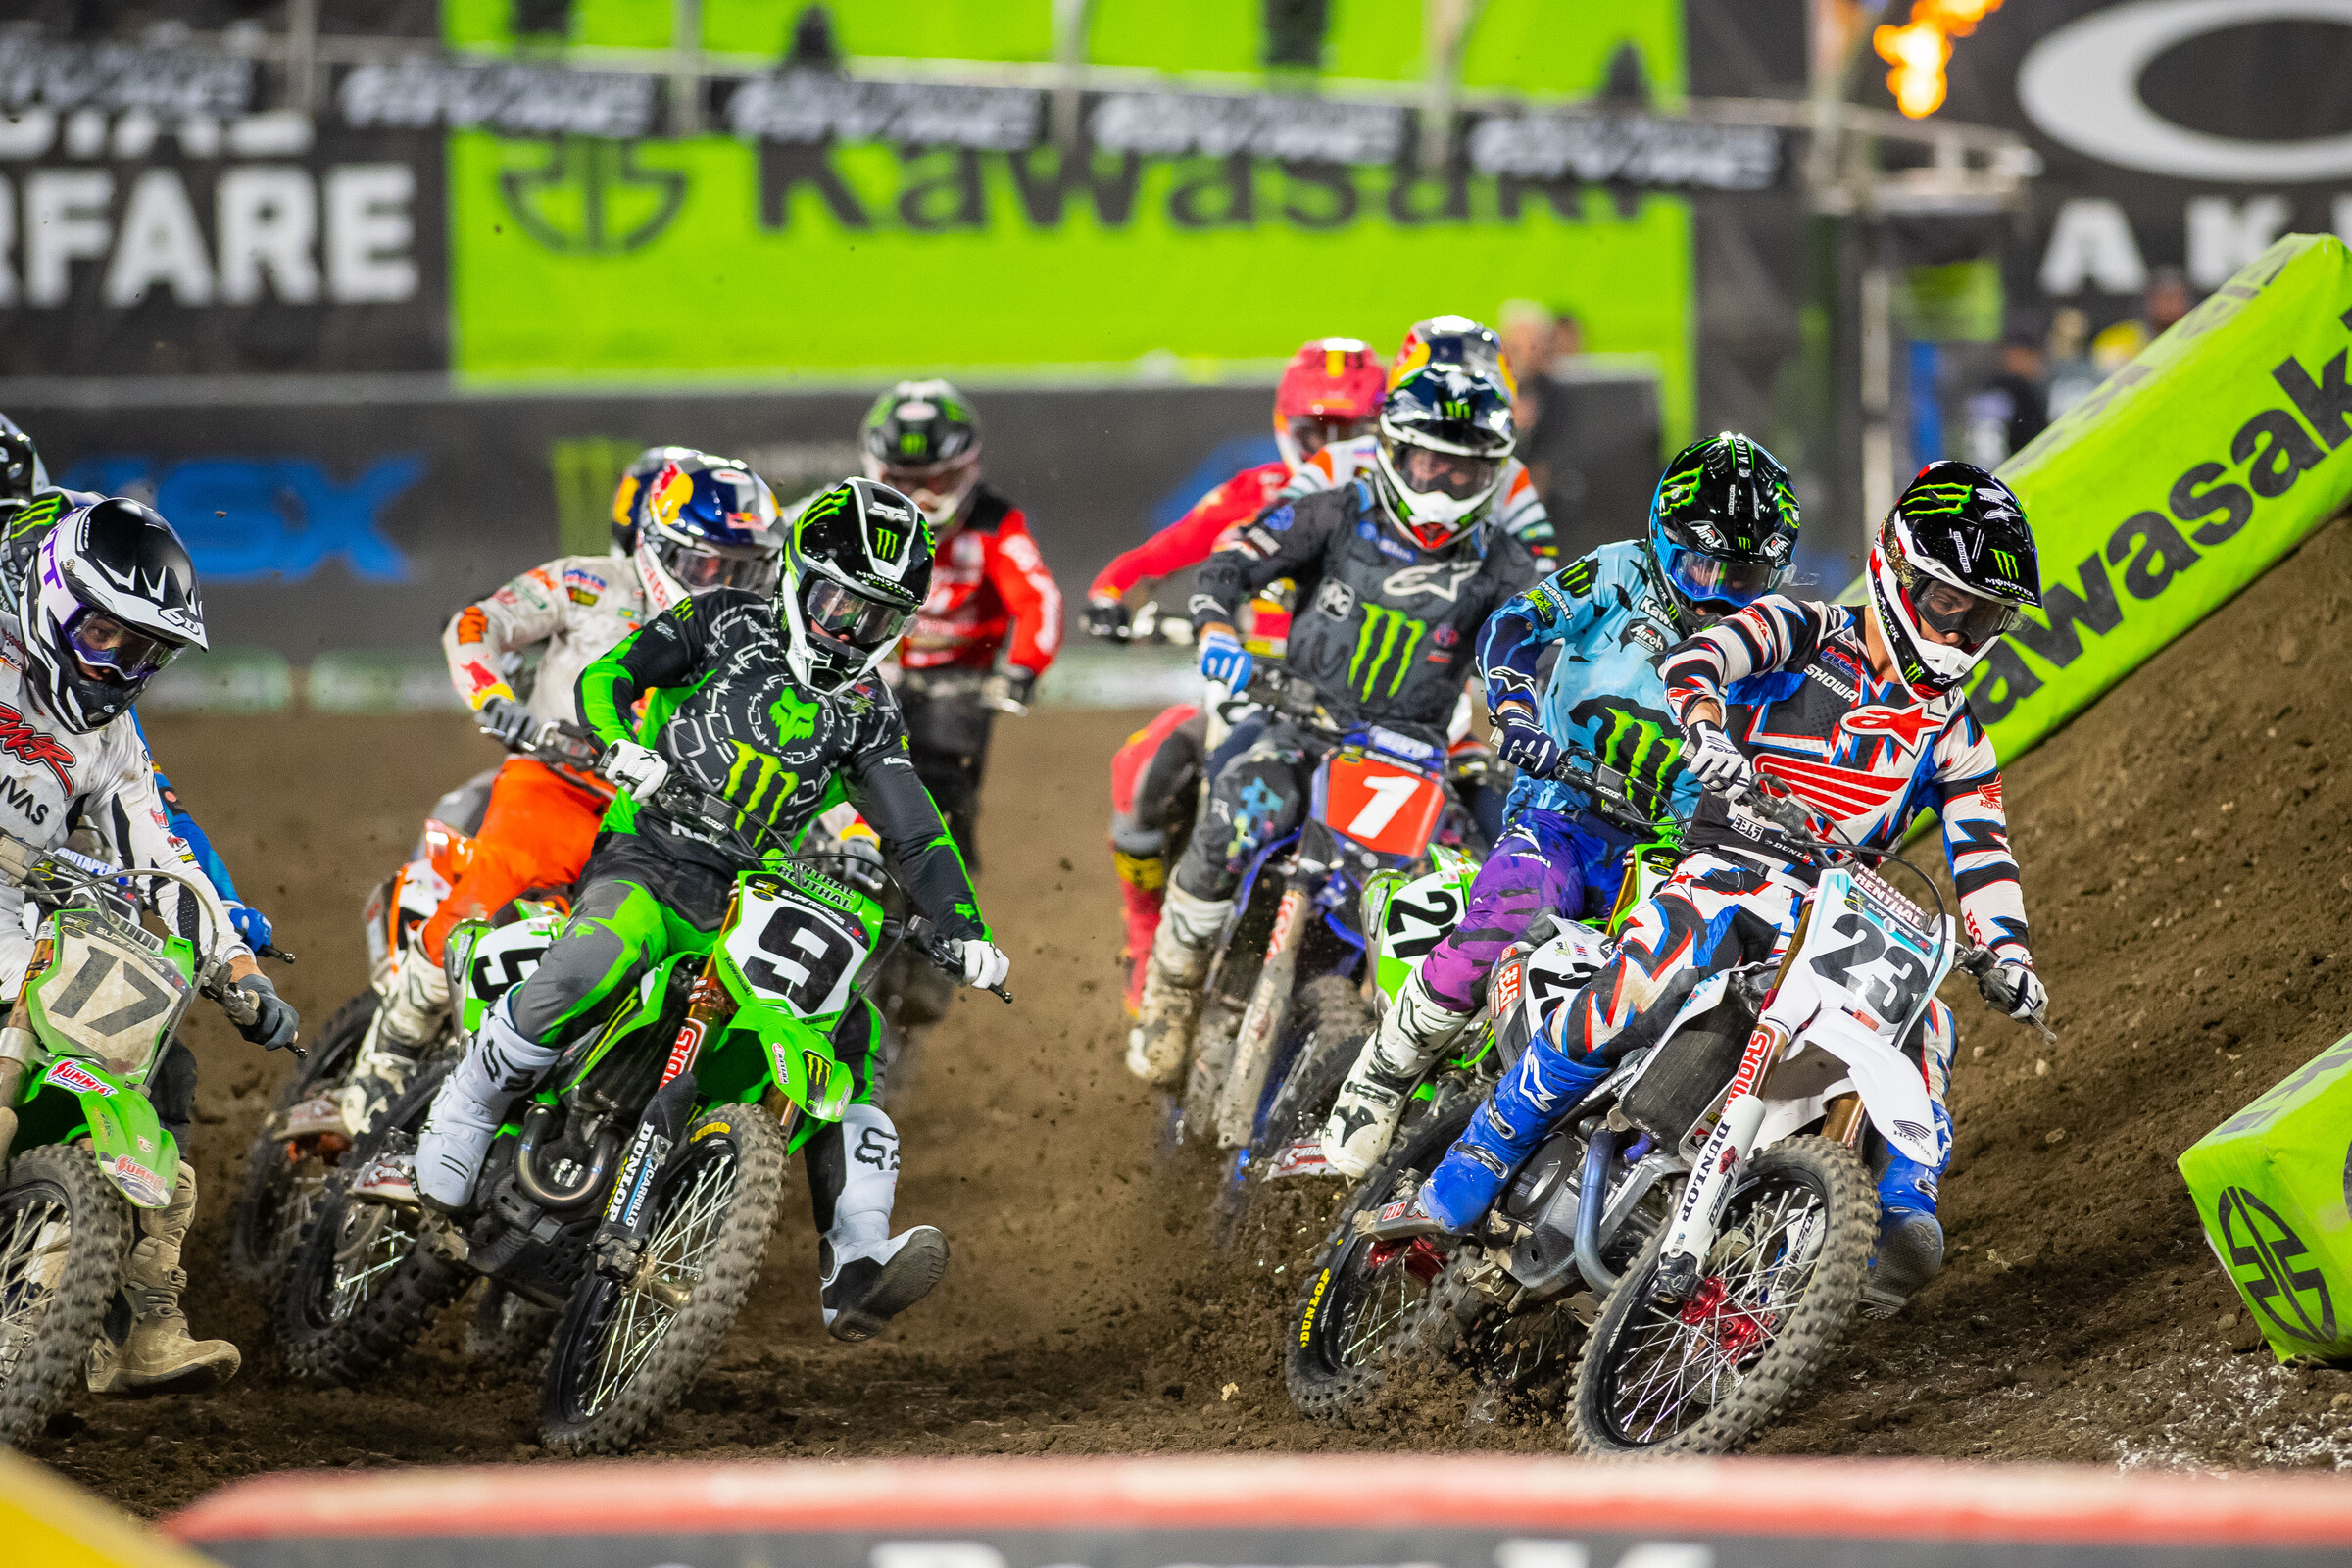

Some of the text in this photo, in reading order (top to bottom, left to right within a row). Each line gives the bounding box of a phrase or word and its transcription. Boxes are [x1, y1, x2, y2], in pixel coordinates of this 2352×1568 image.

[0, 162, 419, 307] FARE
[1979, 494, 2017, 513] HONDA
[1630, 624, 1665, 652] Airoh
[1803, 663, 1861, 703] SHOWA
[1347, 775, 1421, 840] 1
[1772, 841, 1814, 862] DUNLO
[1386, 890, 1458, 959] 21
[1854, 872, 1922, 929] RENTHAL
[49, 945, 172, 1038] 17
[724, 956, 754, 997] Kawasaki
[742, 906, 854, 1015] 9
[1808, 912, 1929, 1024] 23
[1634, 1117, 1661, 1141] Twin Air
[1893, 1128, 1933, 1160] HONDA
[609, 1121, 655, 1223] DUNLOP
[624, 1168, 656, 1228] CARRILLO
[1681, 1119, 1732, 1223] DUNLOP
[1299, 1267, 1331, 1343] DUNLOP
